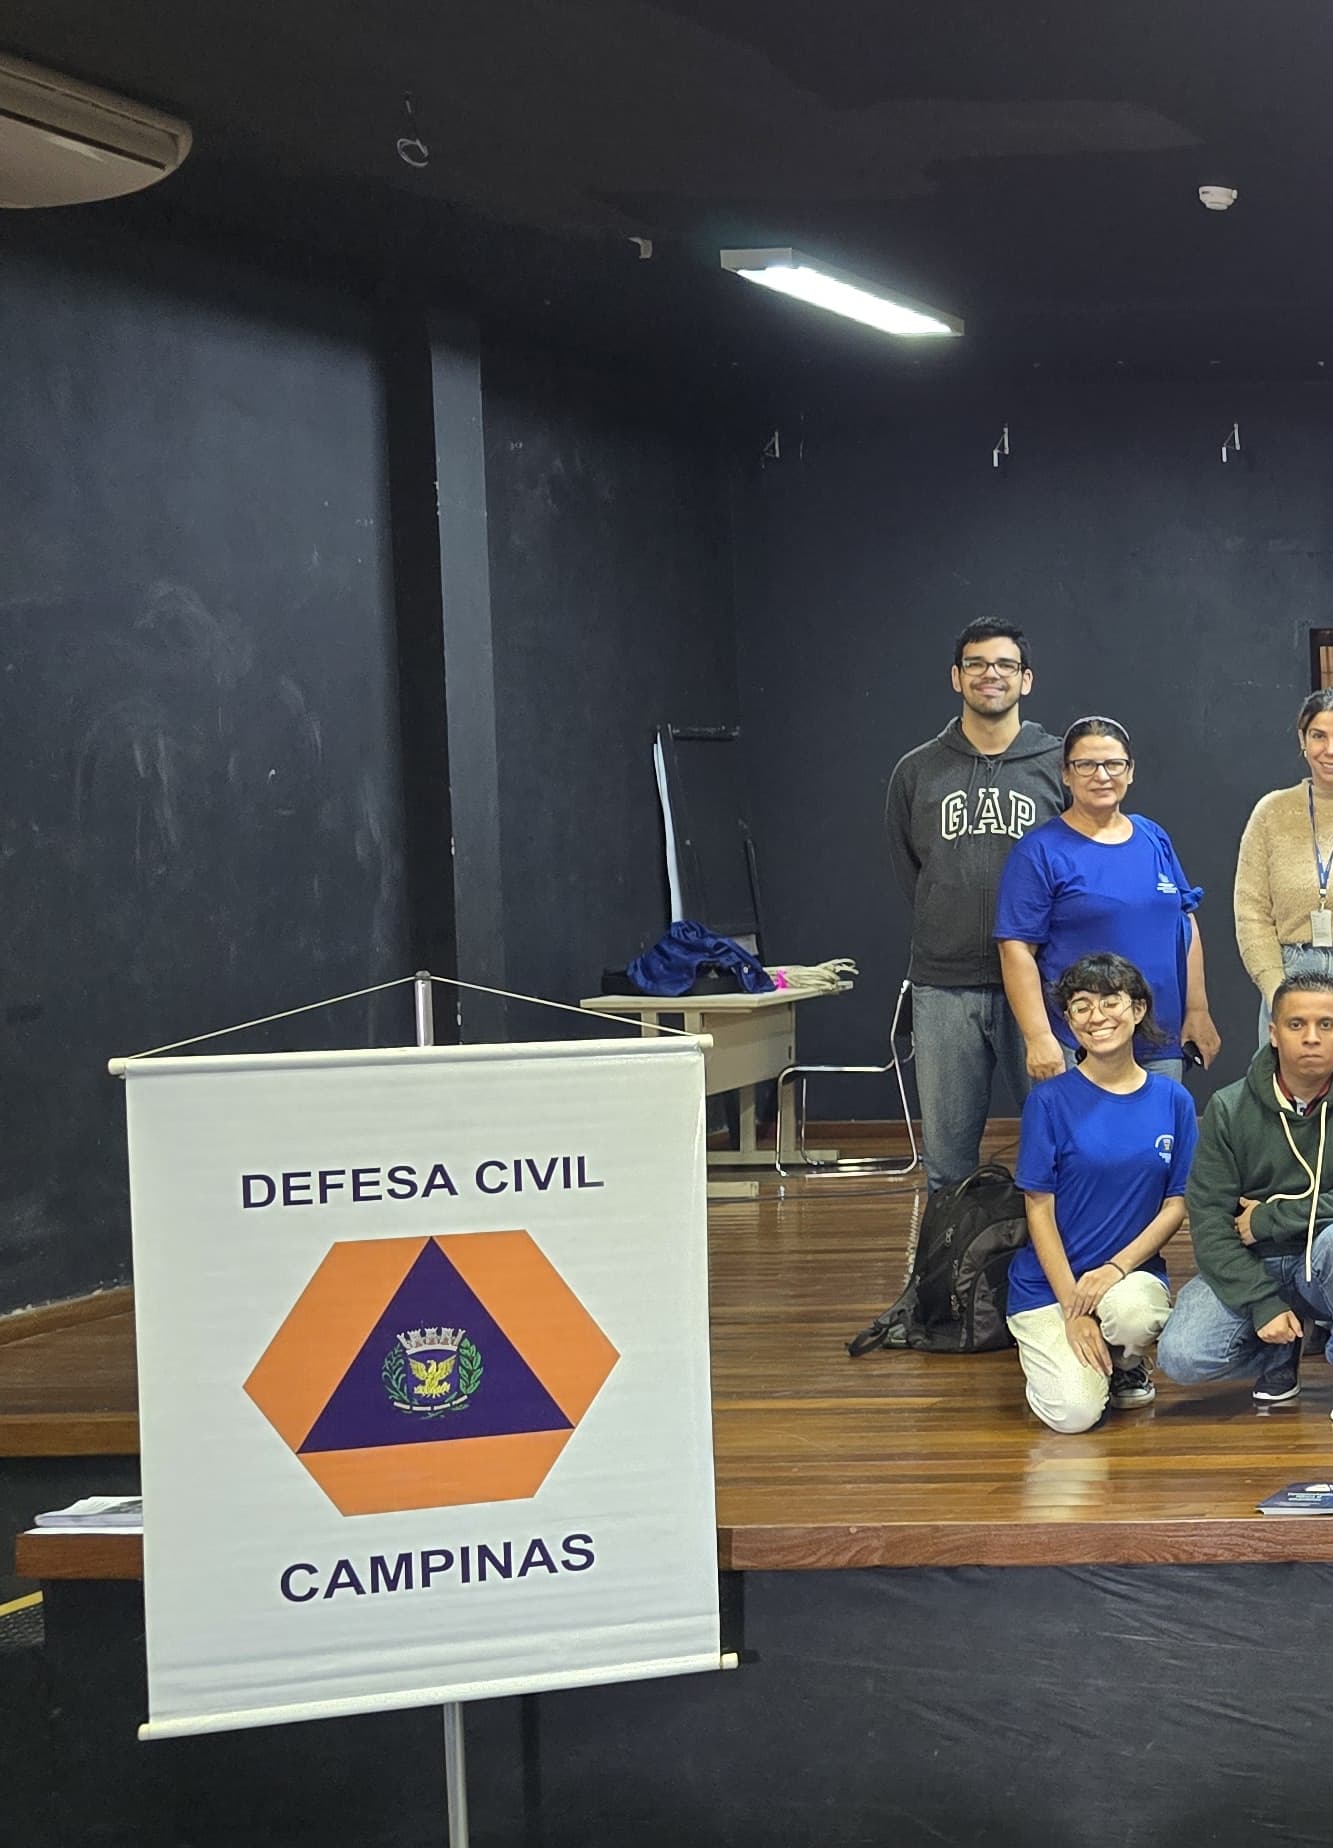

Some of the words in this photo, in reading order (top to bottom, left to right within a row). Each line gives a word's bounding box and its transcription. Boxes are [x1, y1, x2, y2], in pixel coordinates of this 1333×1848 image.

[941, 787, 1036, 840] GAP
[241, 1162, 458, 1210] DEFESA
[474, 1155, 605, 1194] CIVIL
[279, 1533, 596, 1602] CAMPINAS
